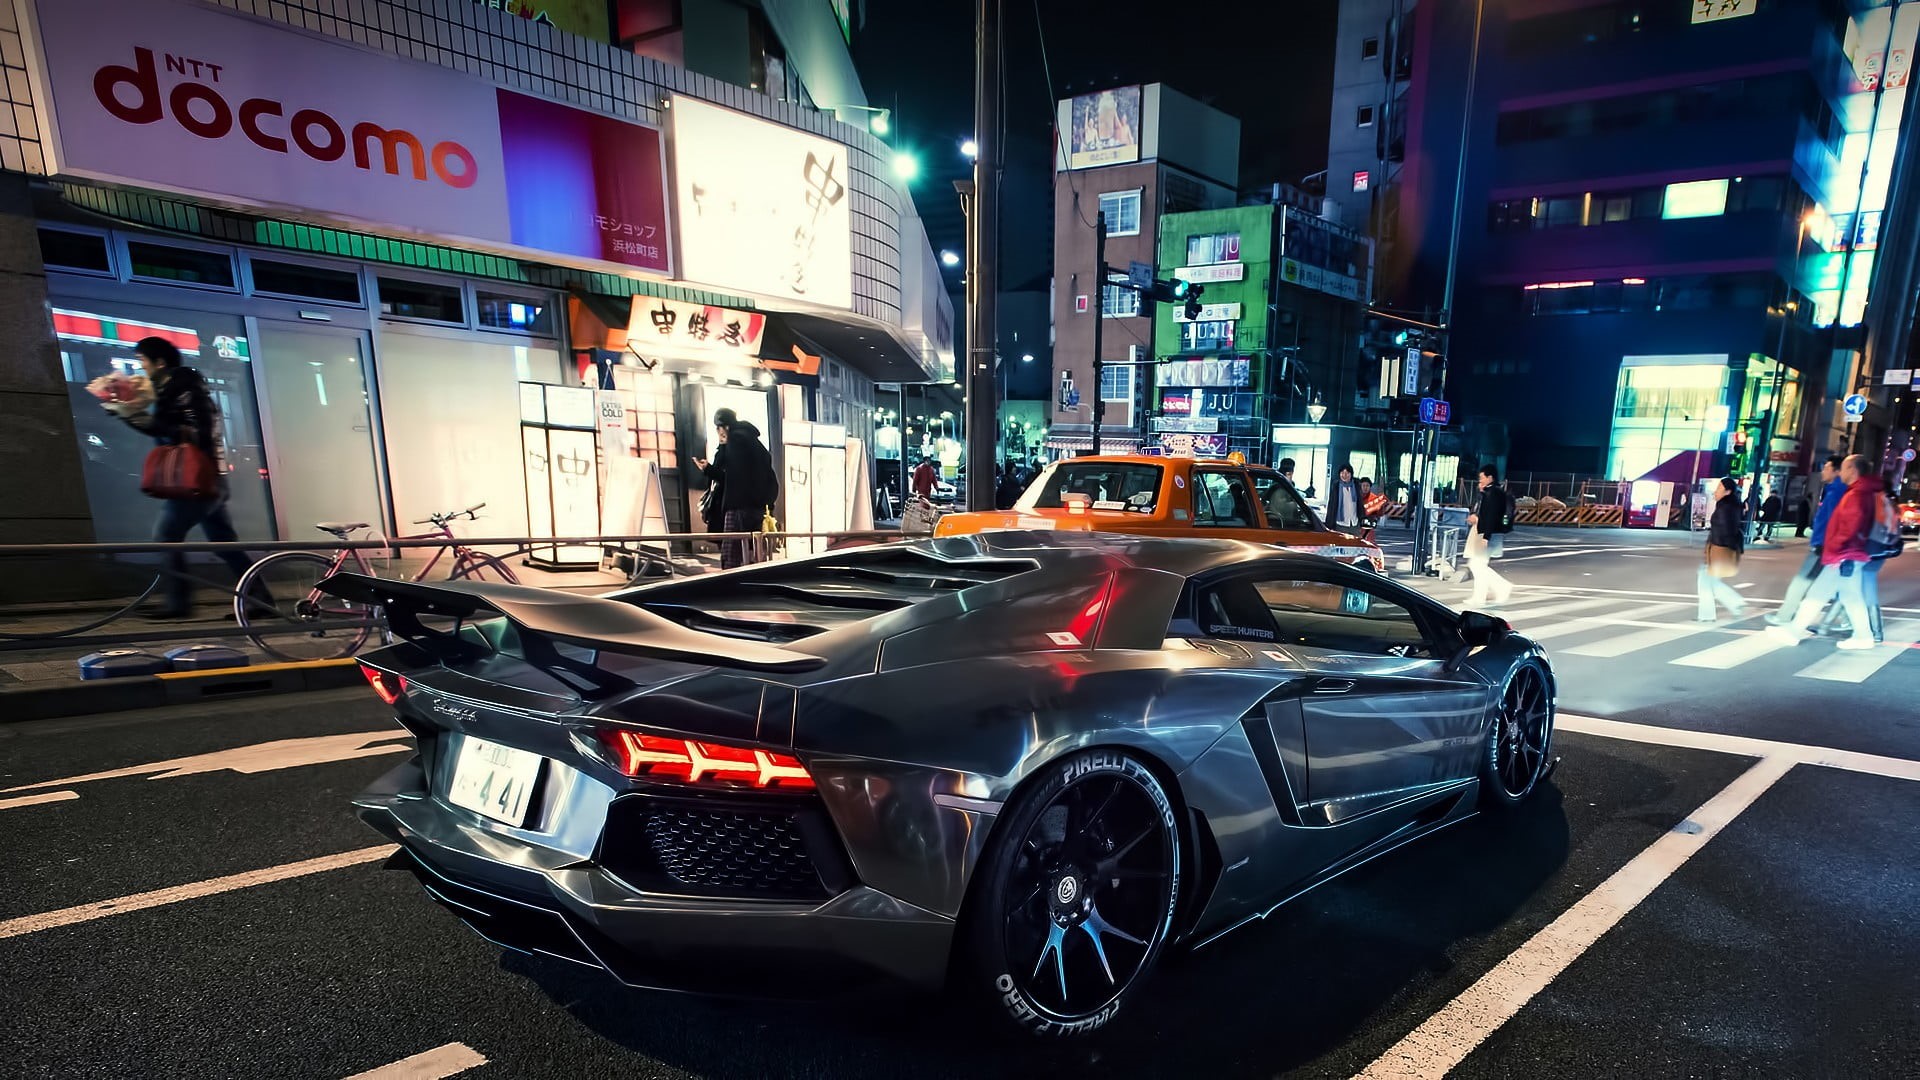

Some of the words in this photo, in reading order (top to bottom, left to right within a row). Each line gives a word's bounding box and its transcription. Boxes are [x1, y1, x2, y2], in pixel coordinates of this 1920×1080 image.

[165, 53, 222, 82] NTT
[93, 47, 478, 189] docomo
[612, 239, 659, 260] 浜松町店
[602, 408, 623, 418] COLD
[1063, 754, 1127, 785] PIRELLI
[996, 973, 1039, 1021] ZERO
